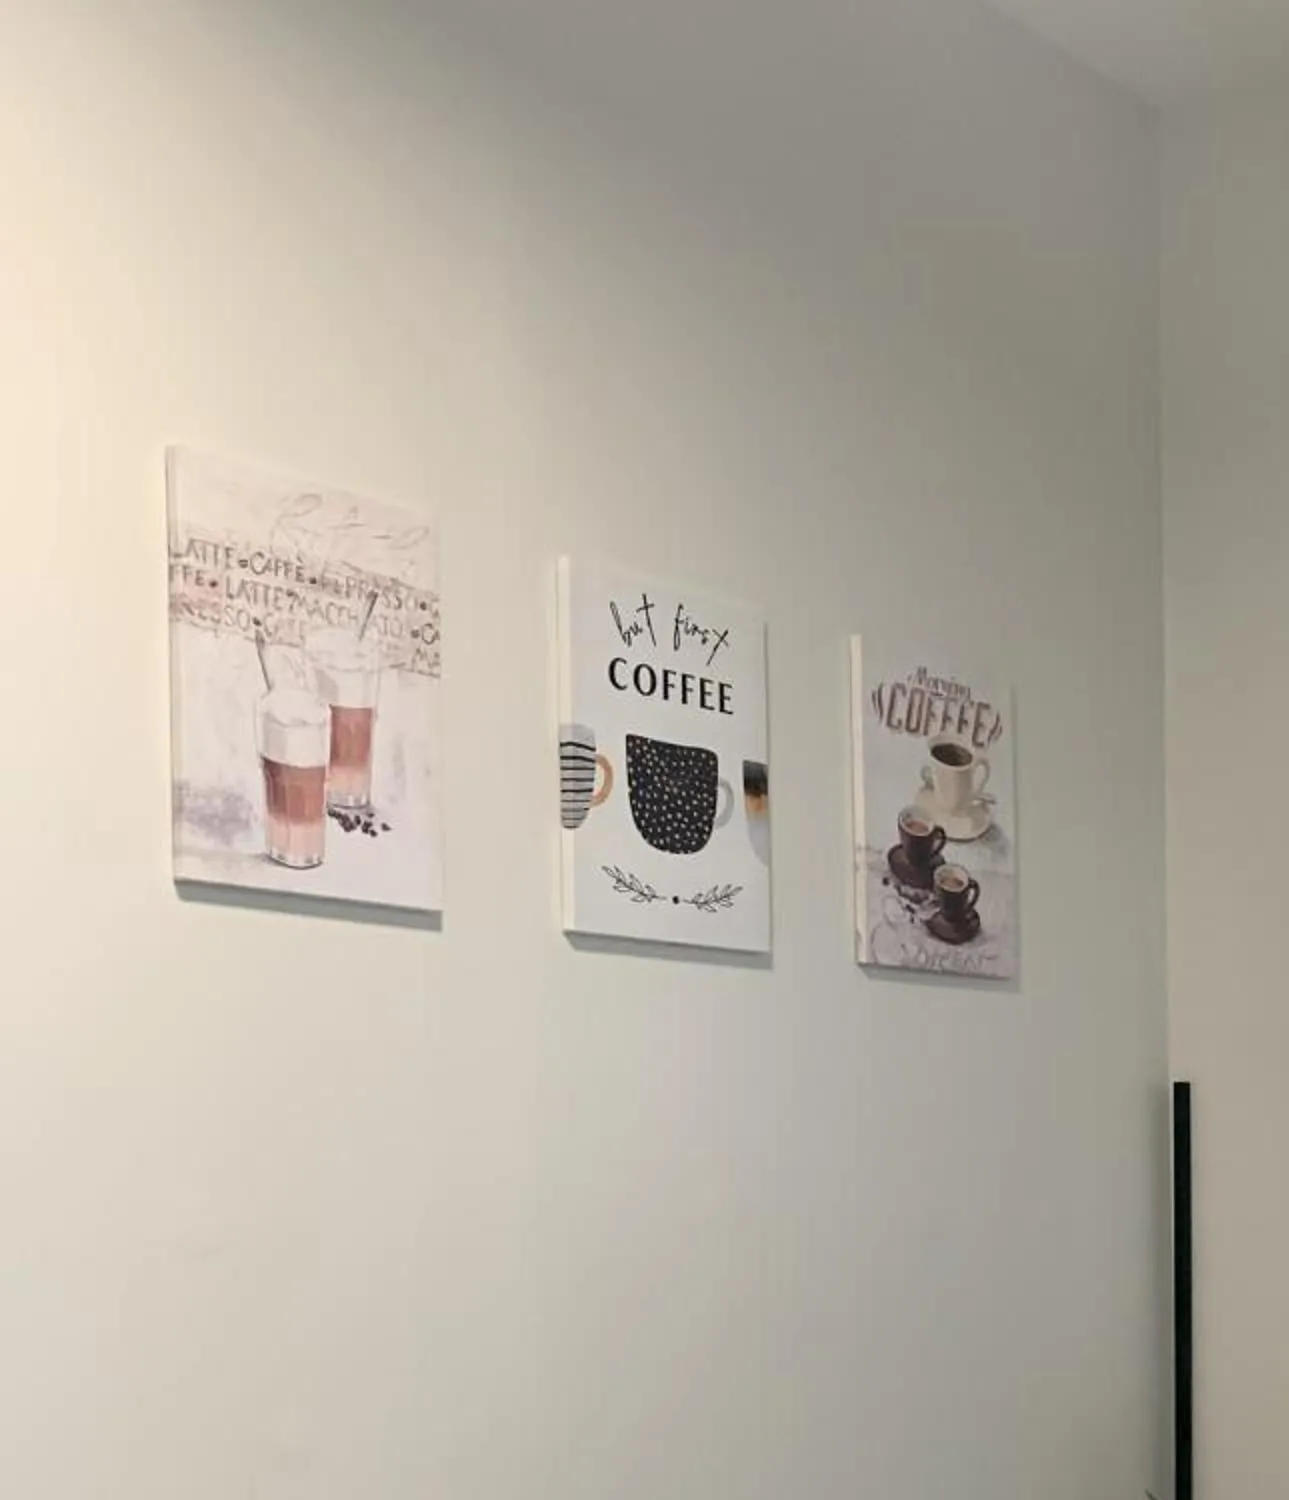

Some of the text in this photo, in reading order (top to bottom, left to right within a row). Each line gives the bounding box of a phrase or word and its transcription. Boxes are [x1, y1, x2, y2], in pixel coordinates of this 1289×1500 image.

[168, 538, 234, 570] LATTE
[225, 576, 283, 612] LATTE
[609, 592, 729, 666] but first
[607, 656, 734, 716] COFFEE
